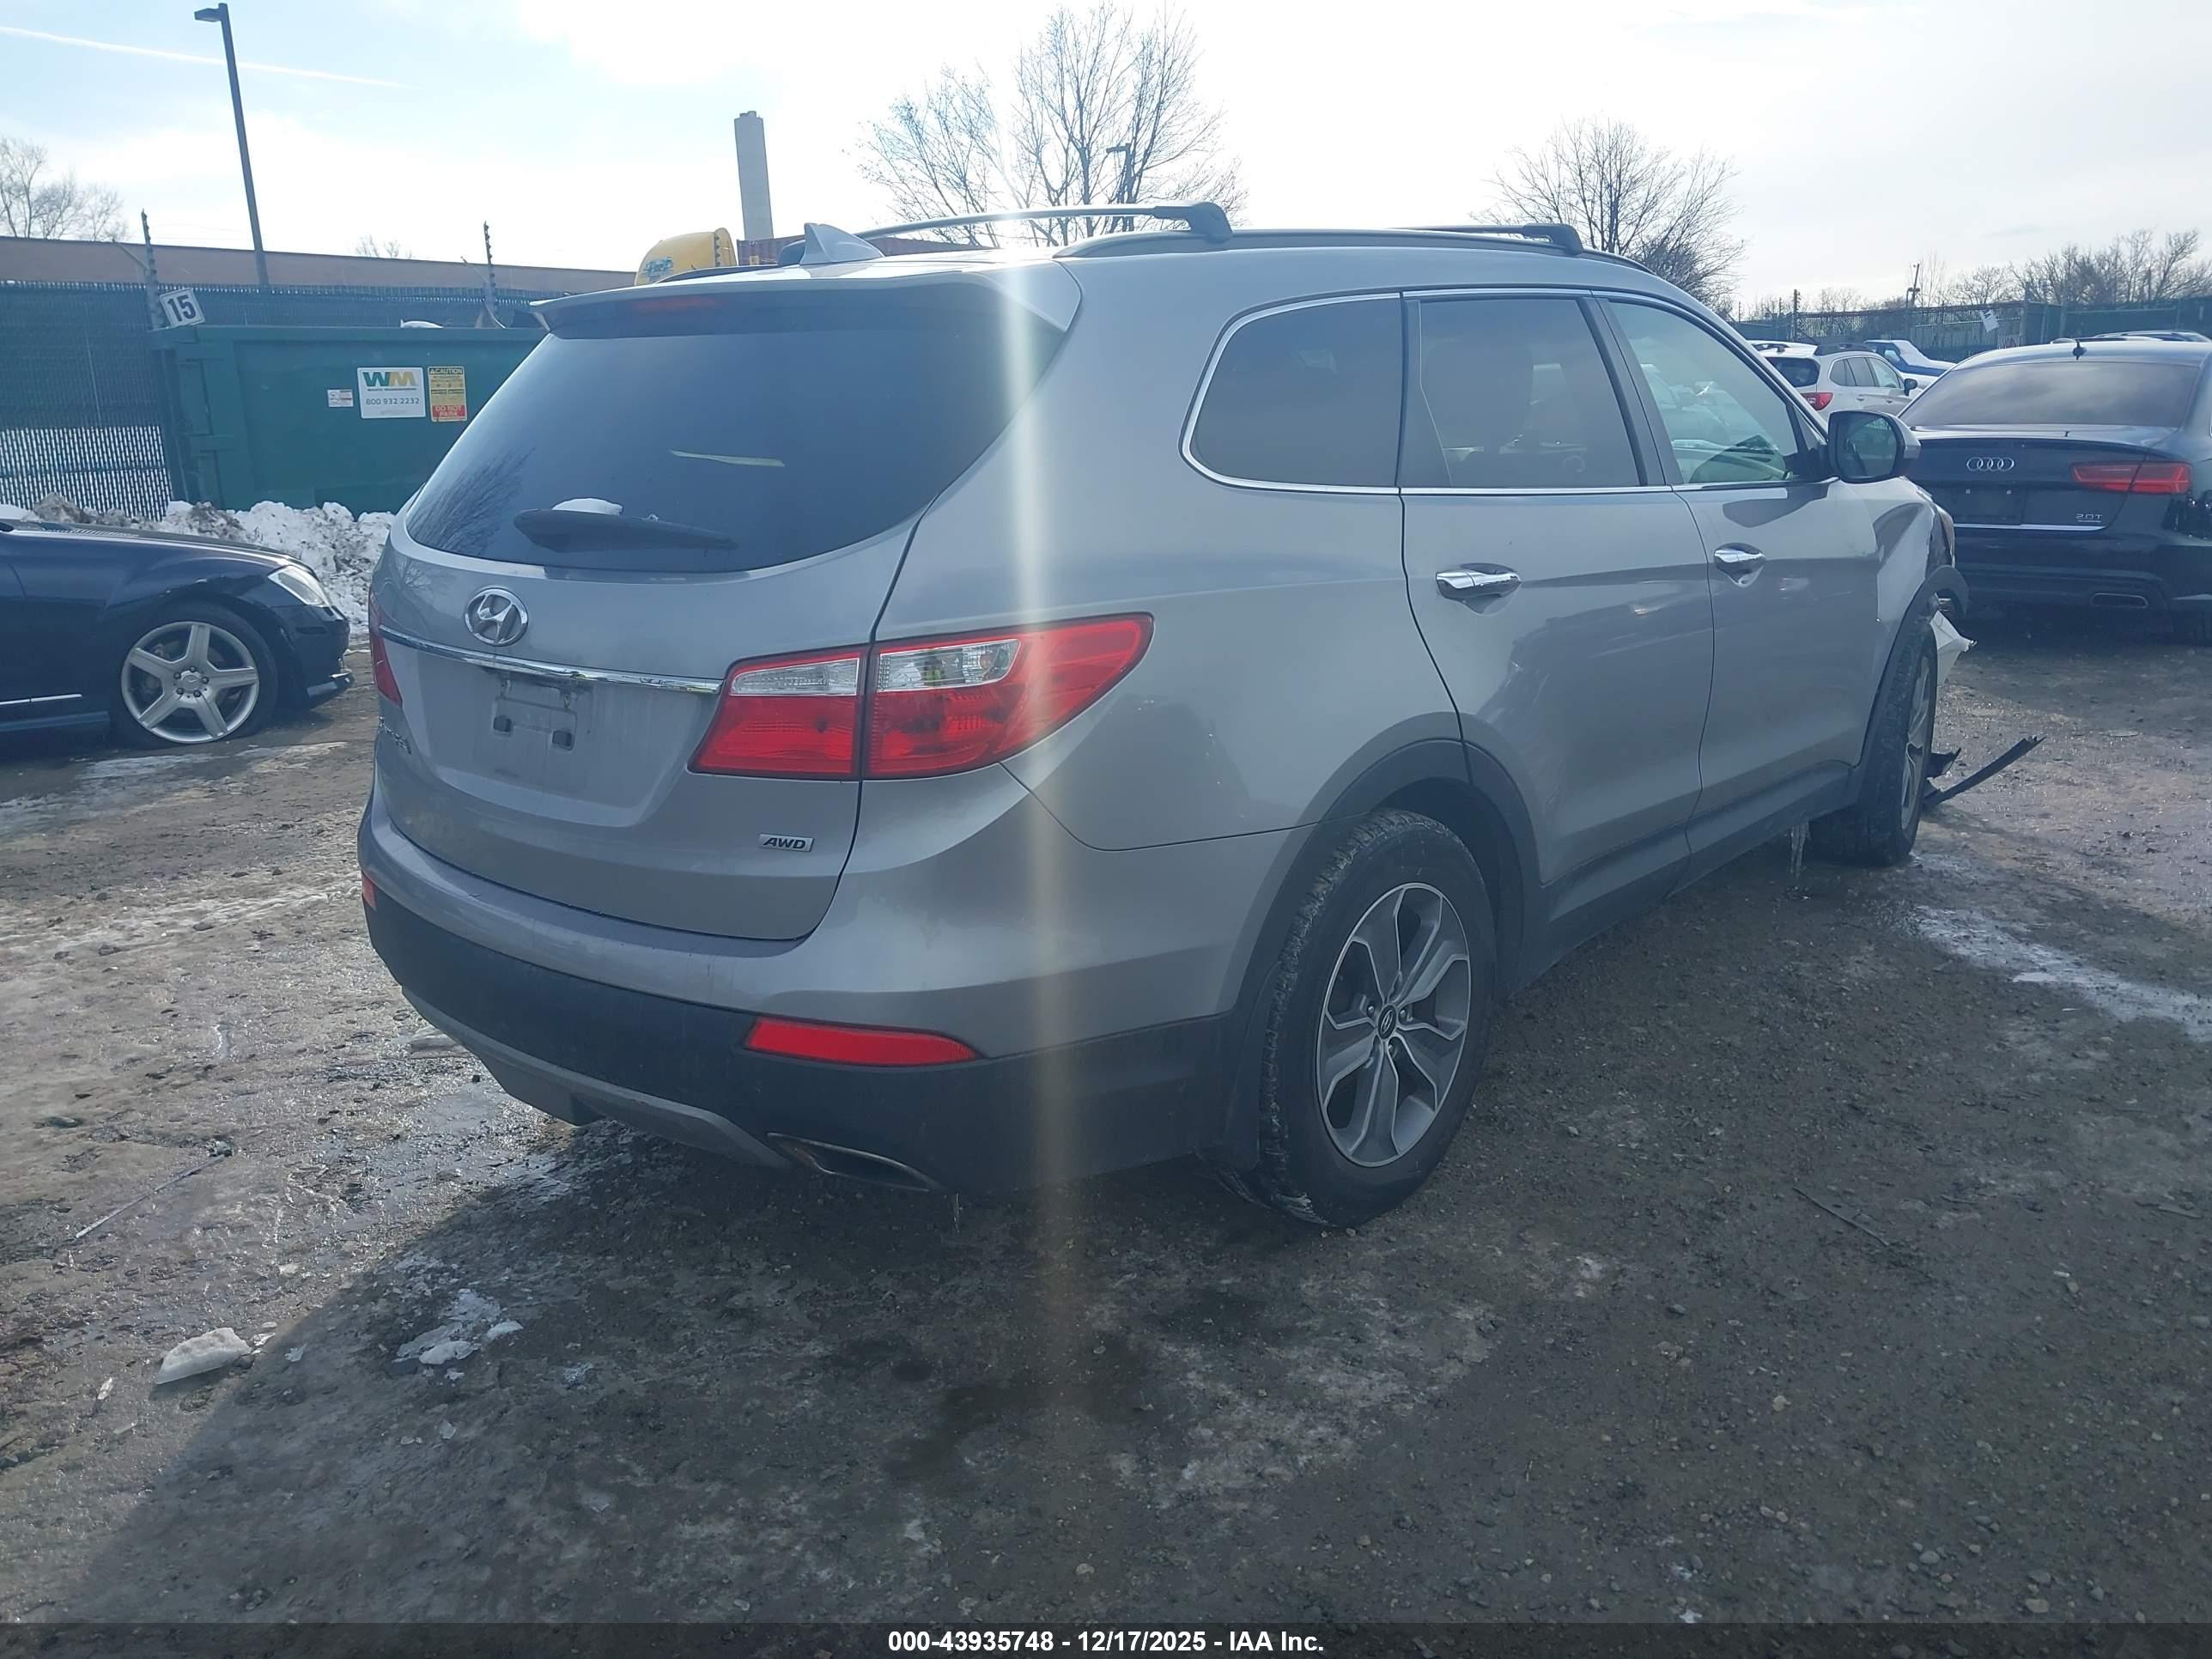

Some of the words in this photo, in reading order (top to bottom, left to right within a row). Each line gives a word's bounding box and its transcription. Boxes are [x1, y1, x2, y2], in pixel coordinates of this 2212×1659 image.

[167, 294, 197, 322] 15
[362, 371, 416, 386] WM
[763, 837, 806, 849] AWD
